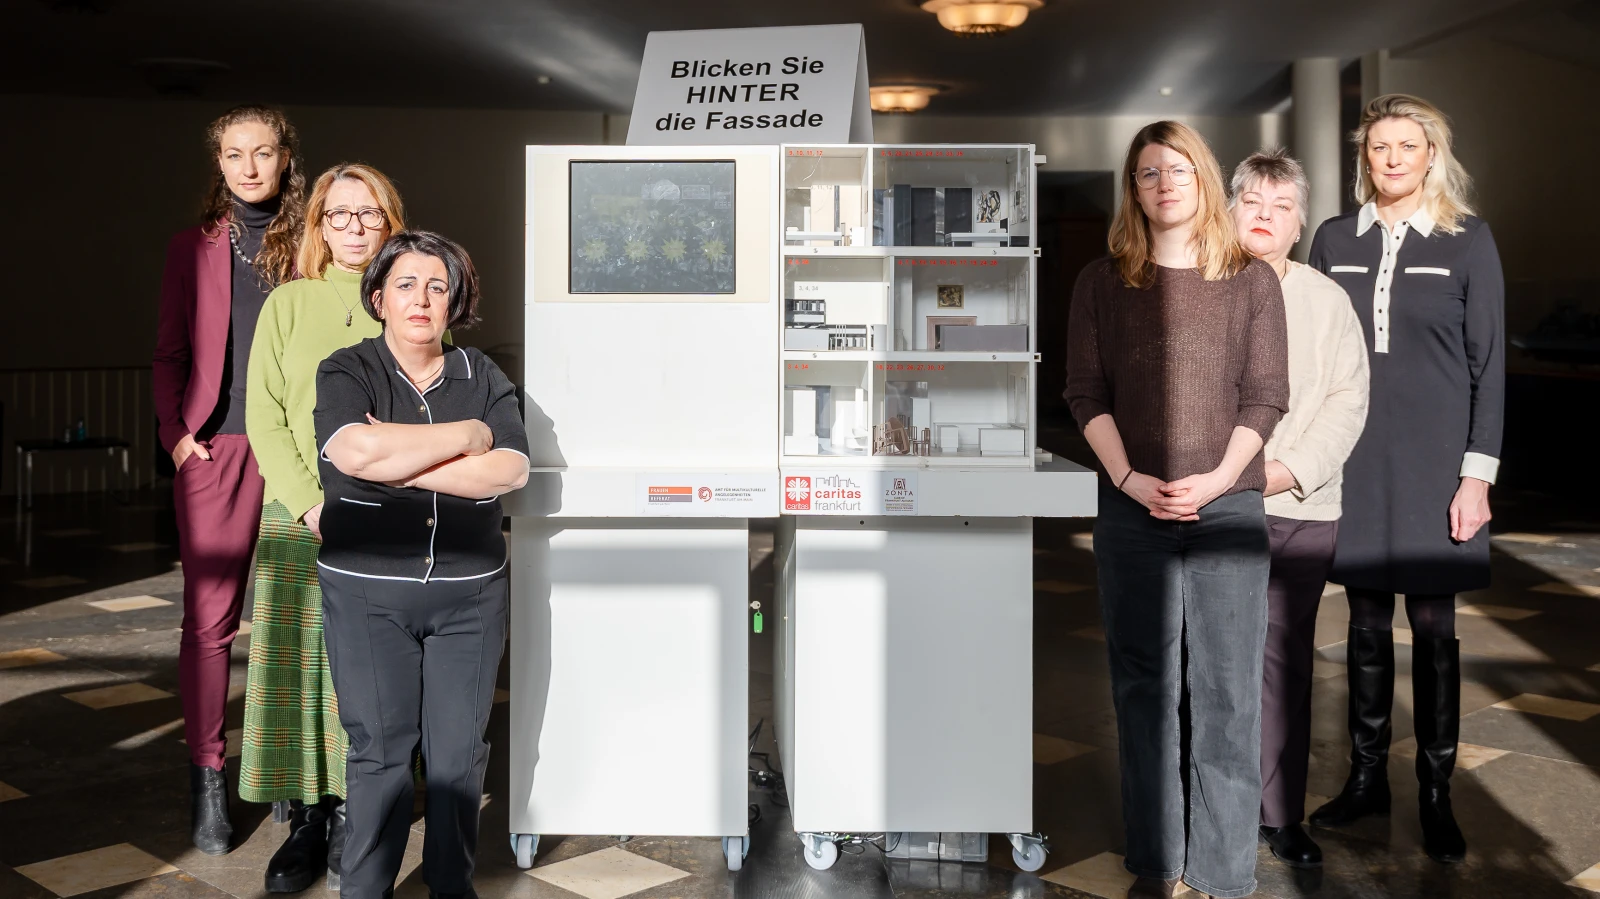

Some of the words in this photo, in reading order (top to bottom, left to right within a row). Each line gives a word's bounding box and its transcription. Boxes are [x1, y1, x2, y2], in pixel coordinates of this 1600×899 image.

[671, 59, 771, 79] Blicken
[781, 56, 824, 75] Sie
[686, 83, 800, 104] HINTER
[655, 112, 696, 131] die
[705, 109, 824, 130] Fassade
[815, 488, 862, 499] caritas
[815, 500, 861, 511] frankfurt
